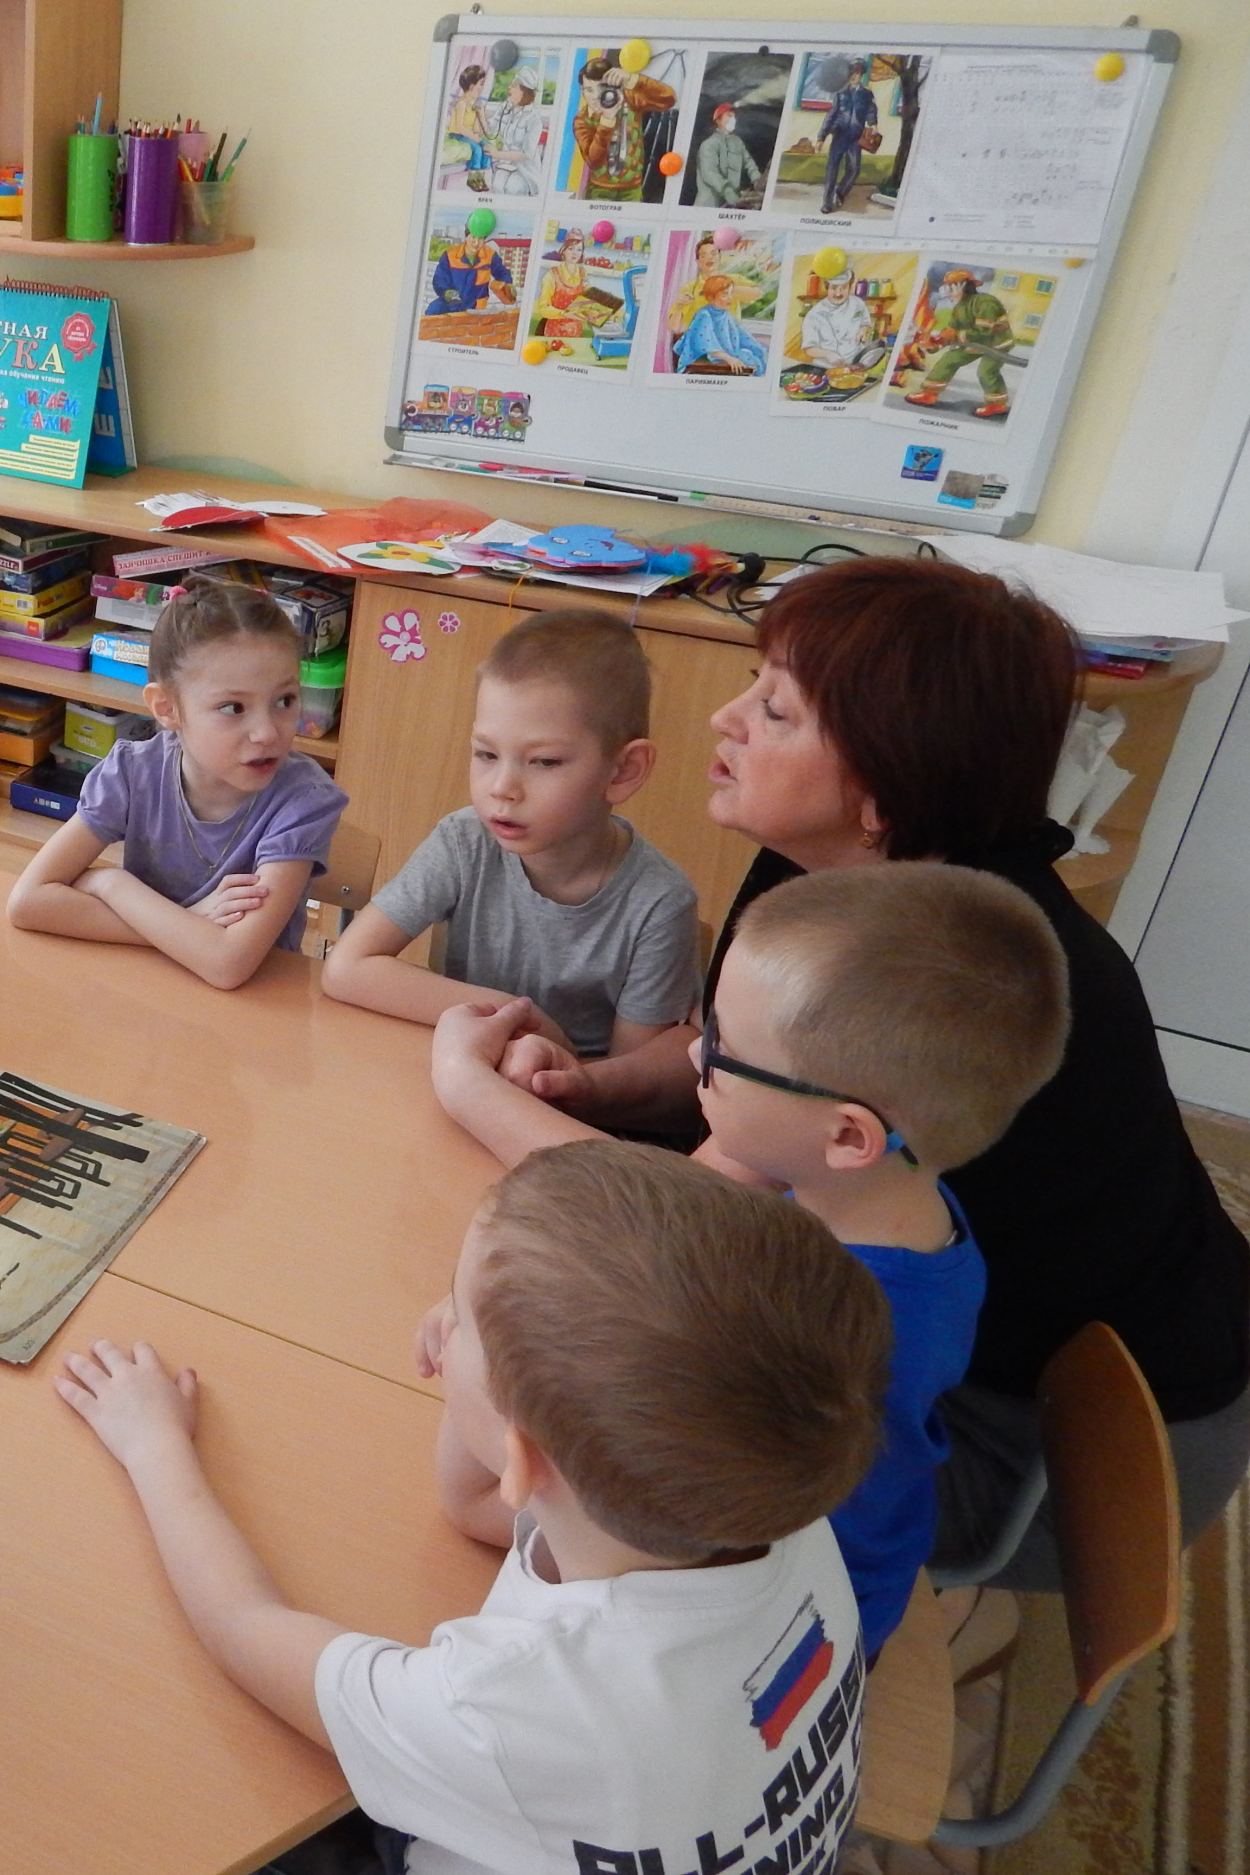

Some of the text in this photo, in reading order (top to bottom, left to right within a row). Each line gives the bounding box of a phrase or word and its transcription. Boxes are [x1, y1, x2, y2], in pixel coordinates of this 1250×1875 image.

[718, 212, 746, 220] ШАХТЁР
[800, 217, 852, 227] ПОЛИЦЕЙСКИЙ
[447, 347, 479, 356] СТРОИТЕЛЬ
[556, 365, 589, 375] ПРОДАВЕЦ
[8, 369, 40, 382] обучения
[41, 374, 65, 385] чтению
[685, 378, 728, 386] ПАРИКМАХЕР
[918, 418, 959, 430] ПОЖАРНИК
